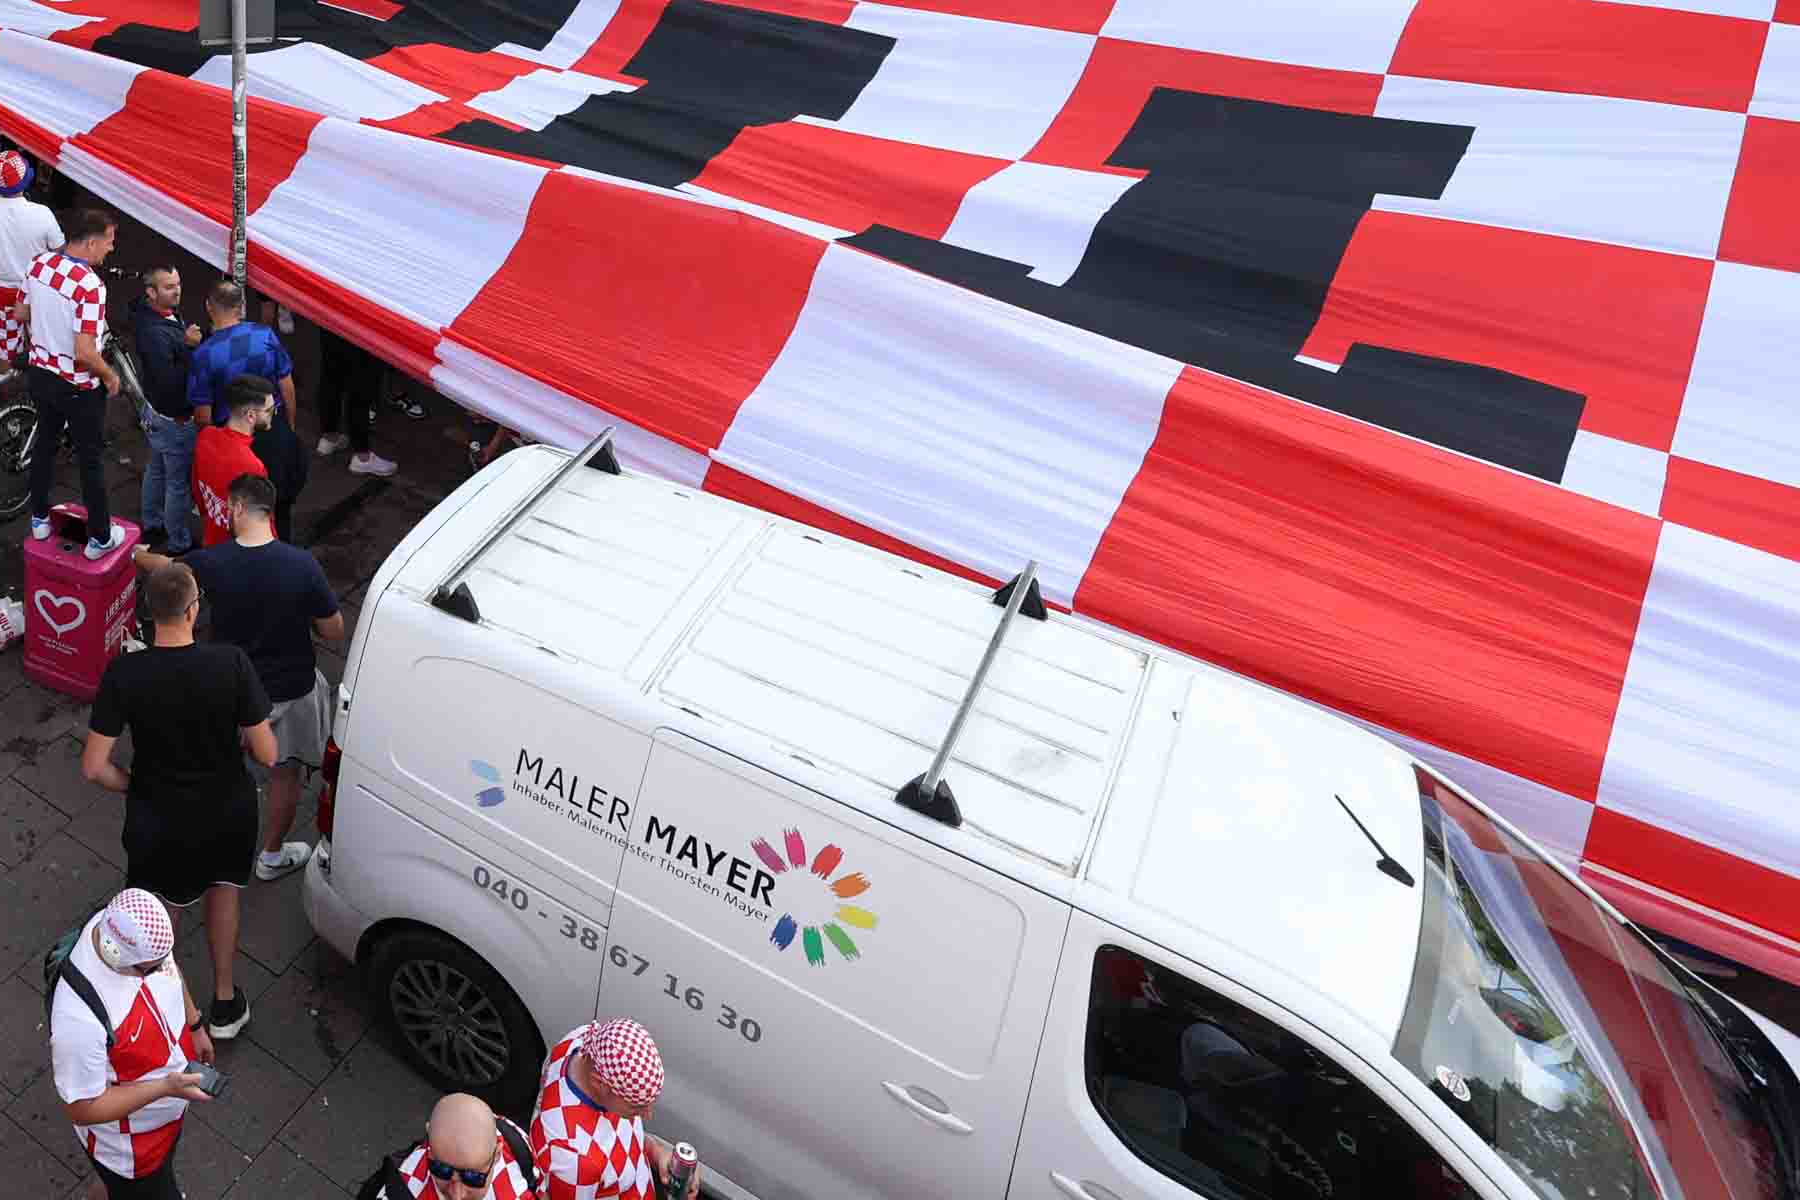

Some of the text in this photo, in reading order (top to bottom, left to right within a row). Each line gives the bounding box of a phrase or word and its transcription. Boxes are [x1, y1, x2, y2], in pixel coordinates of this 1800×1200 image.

[512, 780, 769, 923] Inhaber: Malermeister Thorsten Mayer
[516, 748, 776, 908] MALER MAYER
[473, 865, 529, 911] 040
[559, 915, 600, 952] 38
[609, 944, 651, 977] 67
[663, 973, 705, 1013] 16
[716, 1003, 763, 1044] 30
